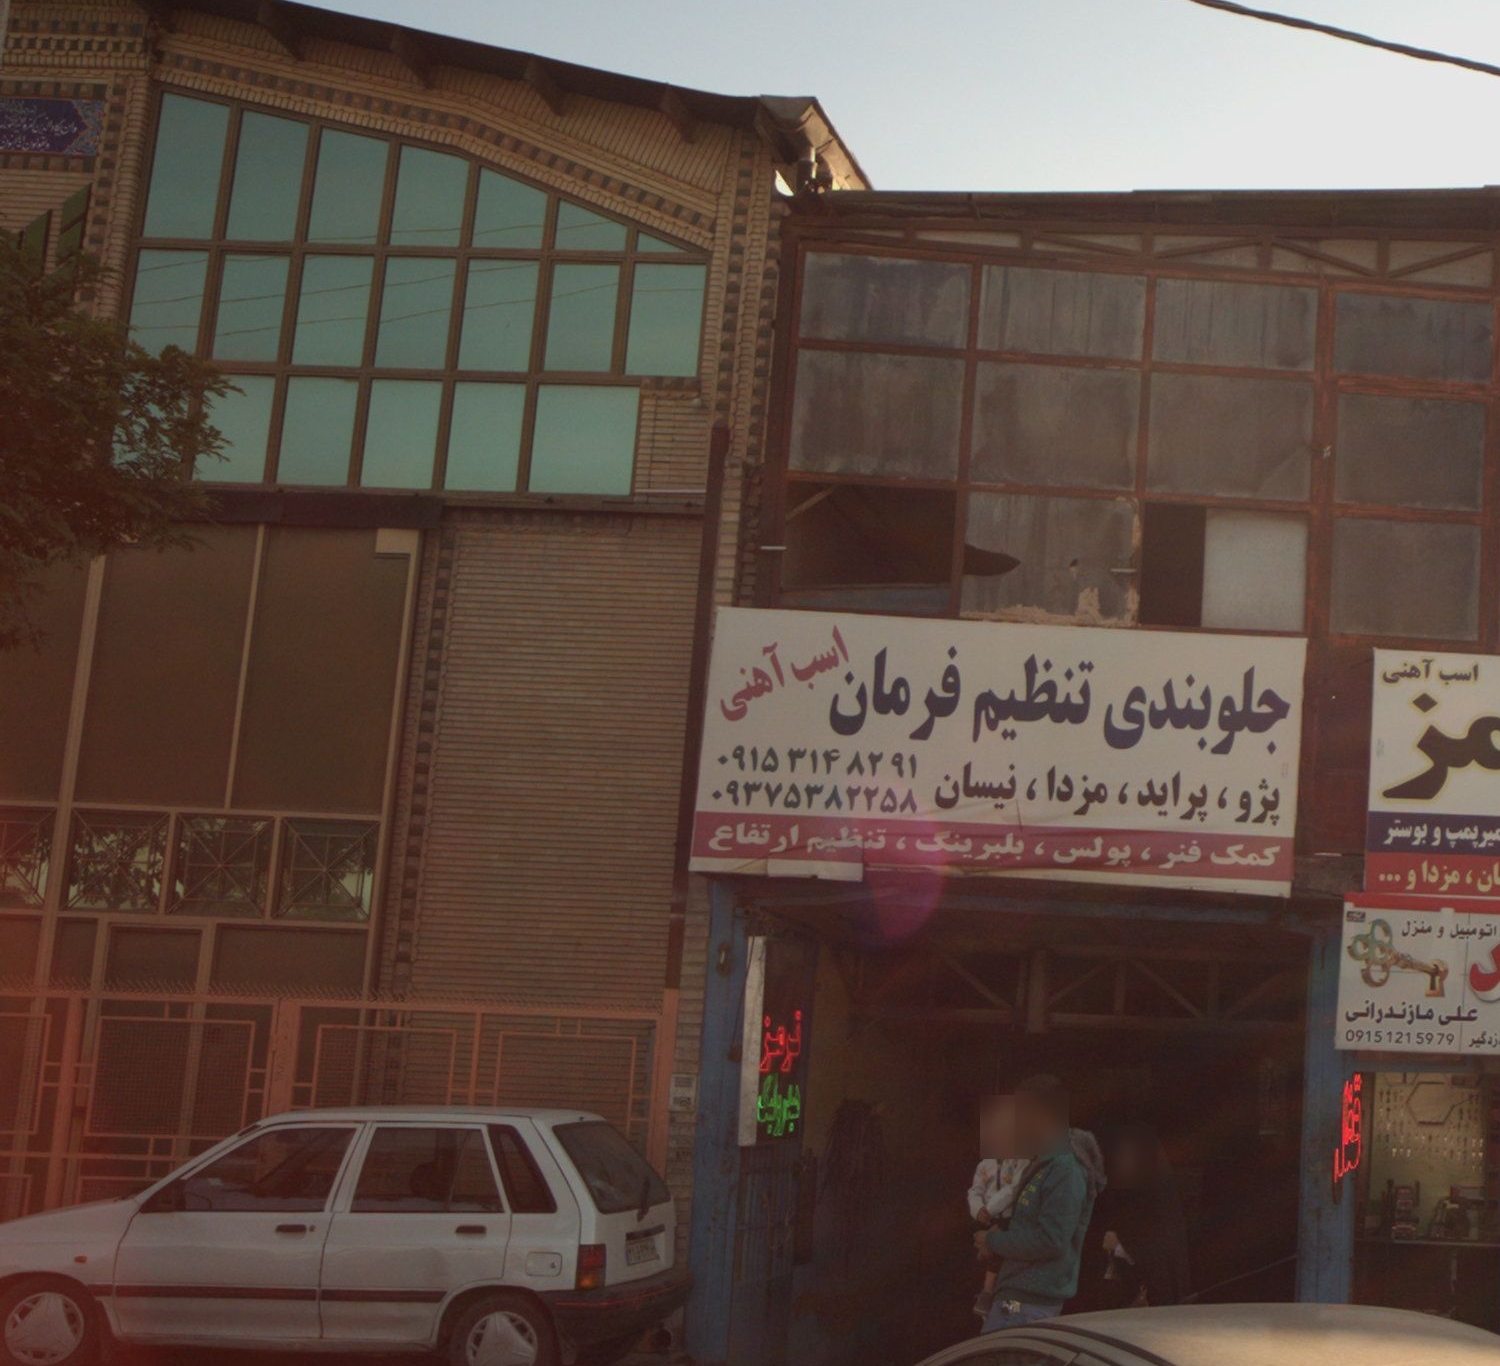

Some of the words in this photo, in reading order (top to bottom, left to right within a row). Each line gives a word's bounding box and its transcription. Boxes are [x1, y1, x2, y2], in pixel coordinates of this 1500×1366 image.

[790, 625, 850, 690] اسب
[1382, 659, 1433, 684] آهنی
[720, 642, 785, 722] آهنی
[1438, 664, 1479, 685] اسب
[829, 646, 962, 741] فرمان
[972, 653, 1095, 743] تنظیم
[1103, 664, 1292, 755] جلوبندی
[934, 761, 1017, 810] نیسان
[708, 822, 799, 853] ارتفاع
[806, 824, 887, 853] تنظیم
[1383, 819, 1427, 847] بوستر
[1431, 830, 1441, 846] و
[1209, 843, 1281, 868] کمک
[1420, 860, 1460, 892] مزدا
[1401, 920, 1432, 937] منزل
[1437, 926, 1444, 938] و
[1449, 923, 1498, 939] اتومبیل
[1345, 1000, 1435, 1025] مازندرانی
[1438, 1005, 1478, 1025] علی
